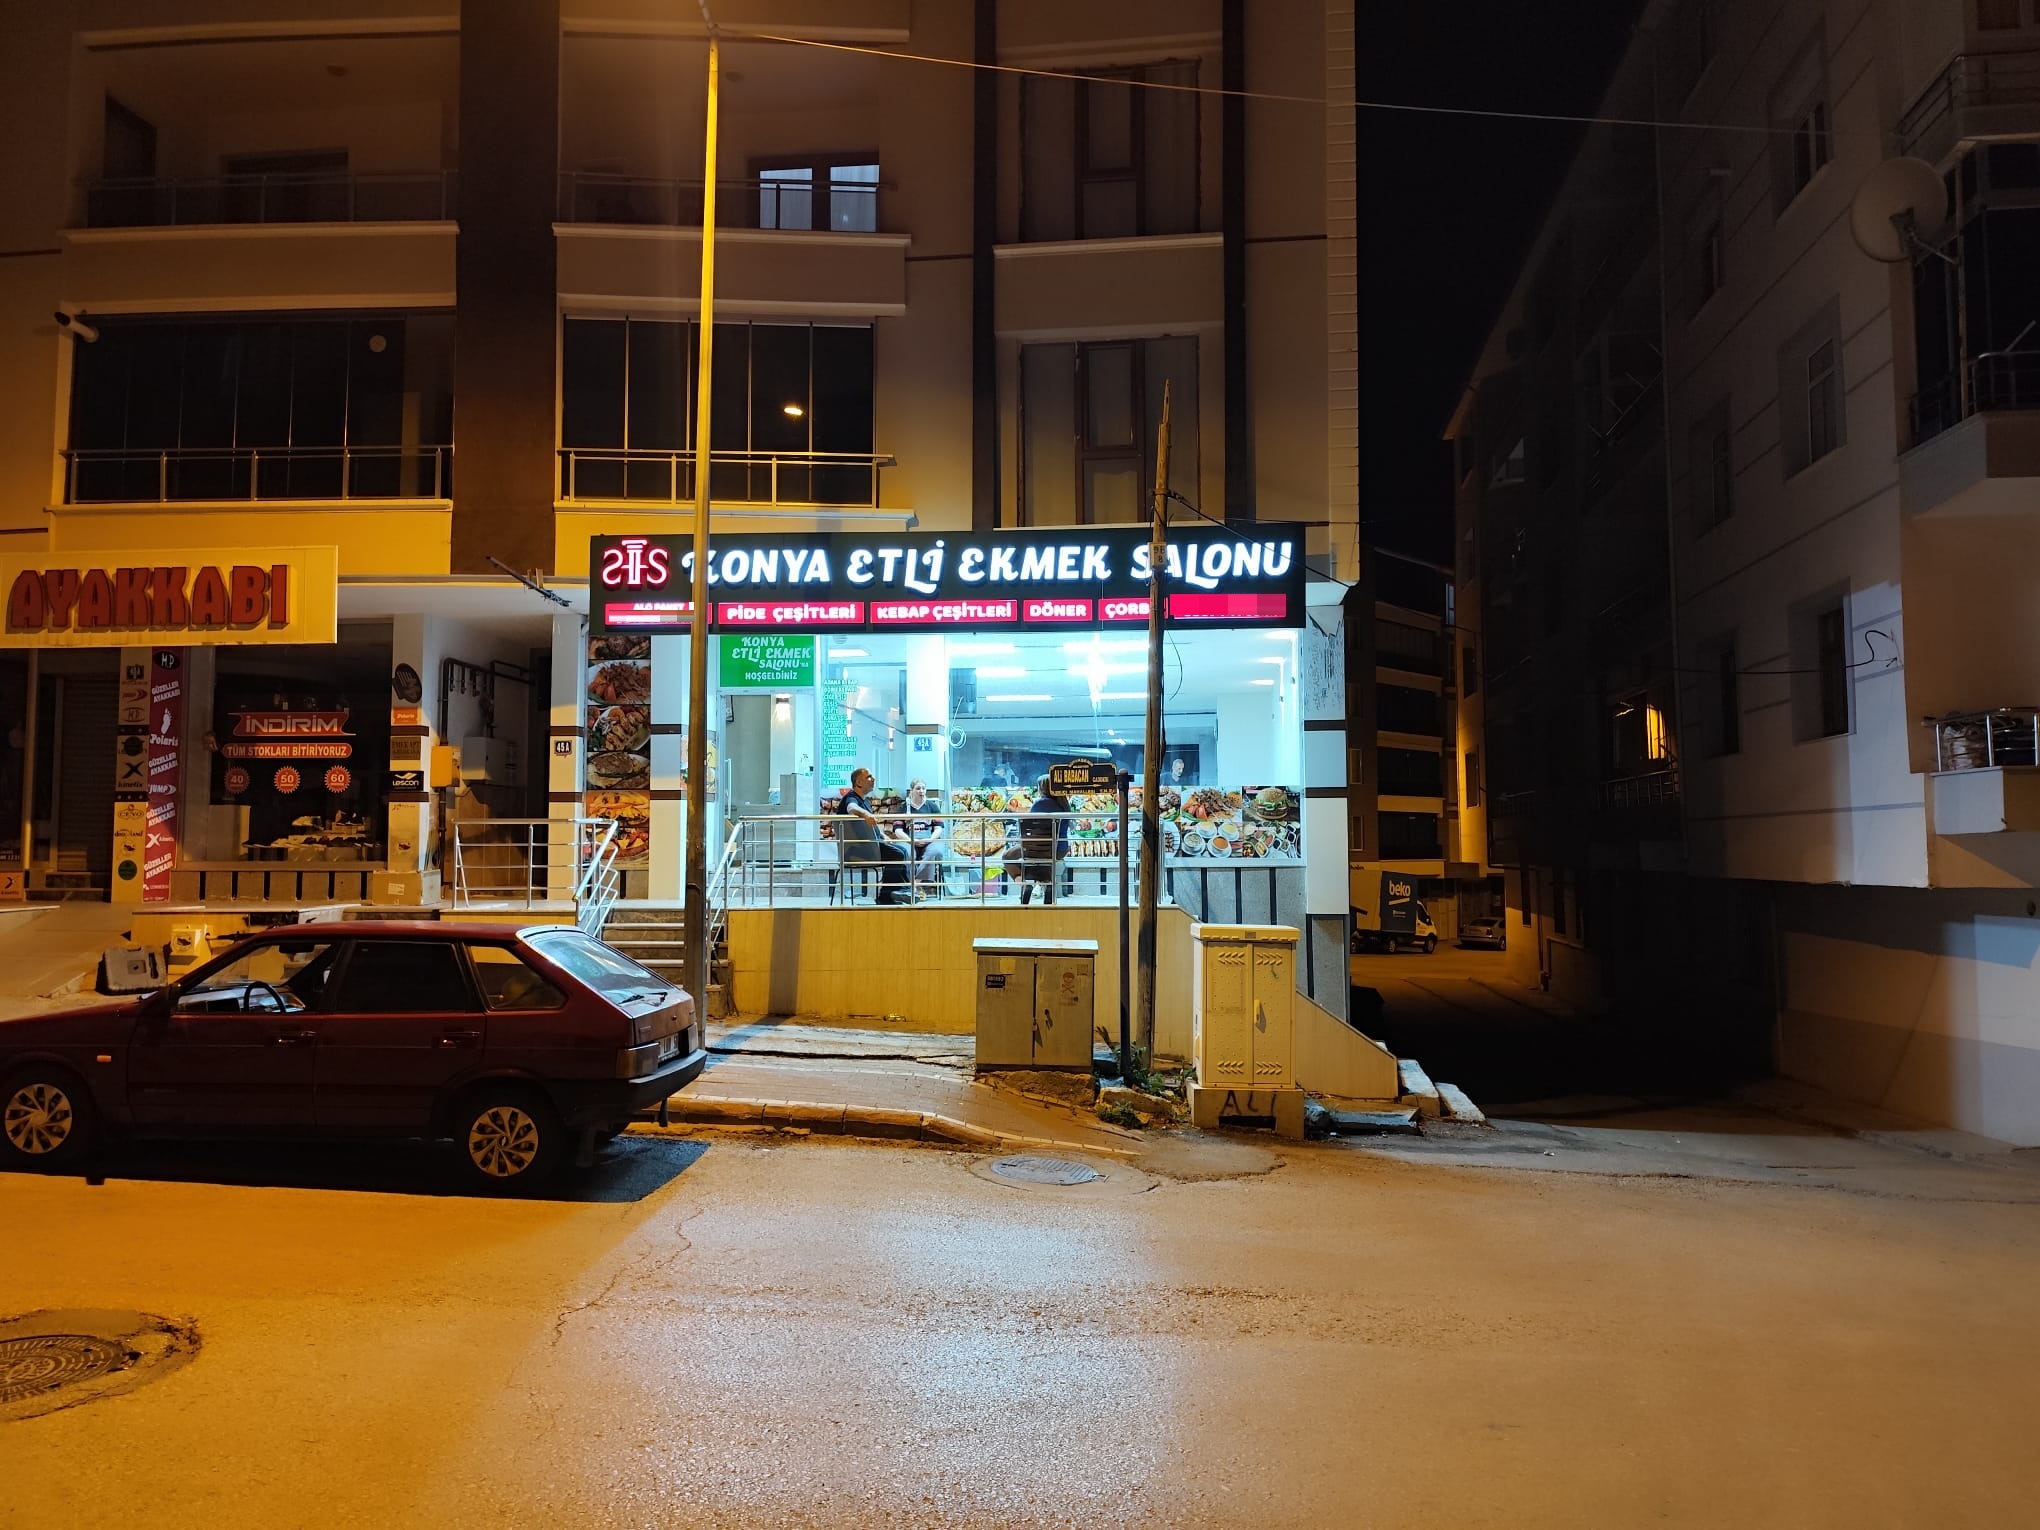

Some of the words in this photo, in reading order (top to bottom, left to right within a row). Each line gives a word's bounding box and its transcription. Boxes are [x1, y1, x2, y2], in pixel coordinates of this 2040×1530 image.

[682, 549, 831, 584] KONYA
[846, 539, 945, 594] ETLİ
[958, 545, 1113, 582] EKMEK
[9, 563, 291, 630] AYAKKABI
[727, 604, 766, 620] PİDE
[772, 603, 856, 623] ÇEŞİTLERİ
[877, 605, 929, 619] KEBAP
[932, 601, 1011, 621] ÇEŞİTLERİ
[1029, 600, 1087, 617] DÖNER
[1105, 602, 1150, 617] ÇORB
[742, 636, 785, 647] KONYA
[732, 646, 761, 662] ETLİ
[766, 647, 811, 659] EKMEK
[745, 670, 798, 682] HOŞGELDİNİZ
[246, 715, 339, 732] İNDİRİM
[150, 733, 179, 747] Polaris
[227, 743, 247, 756] TÜM
[248, 745, 290, 756] STOKLARI
[292, 743, 347, 756] BİTİRİYORUZ
[230, 775, 244, 784] 40
[280, 775, 295, 784] 50
[330, 774, 345, 783] 60
[1389, 880, 1411, 896] beko
